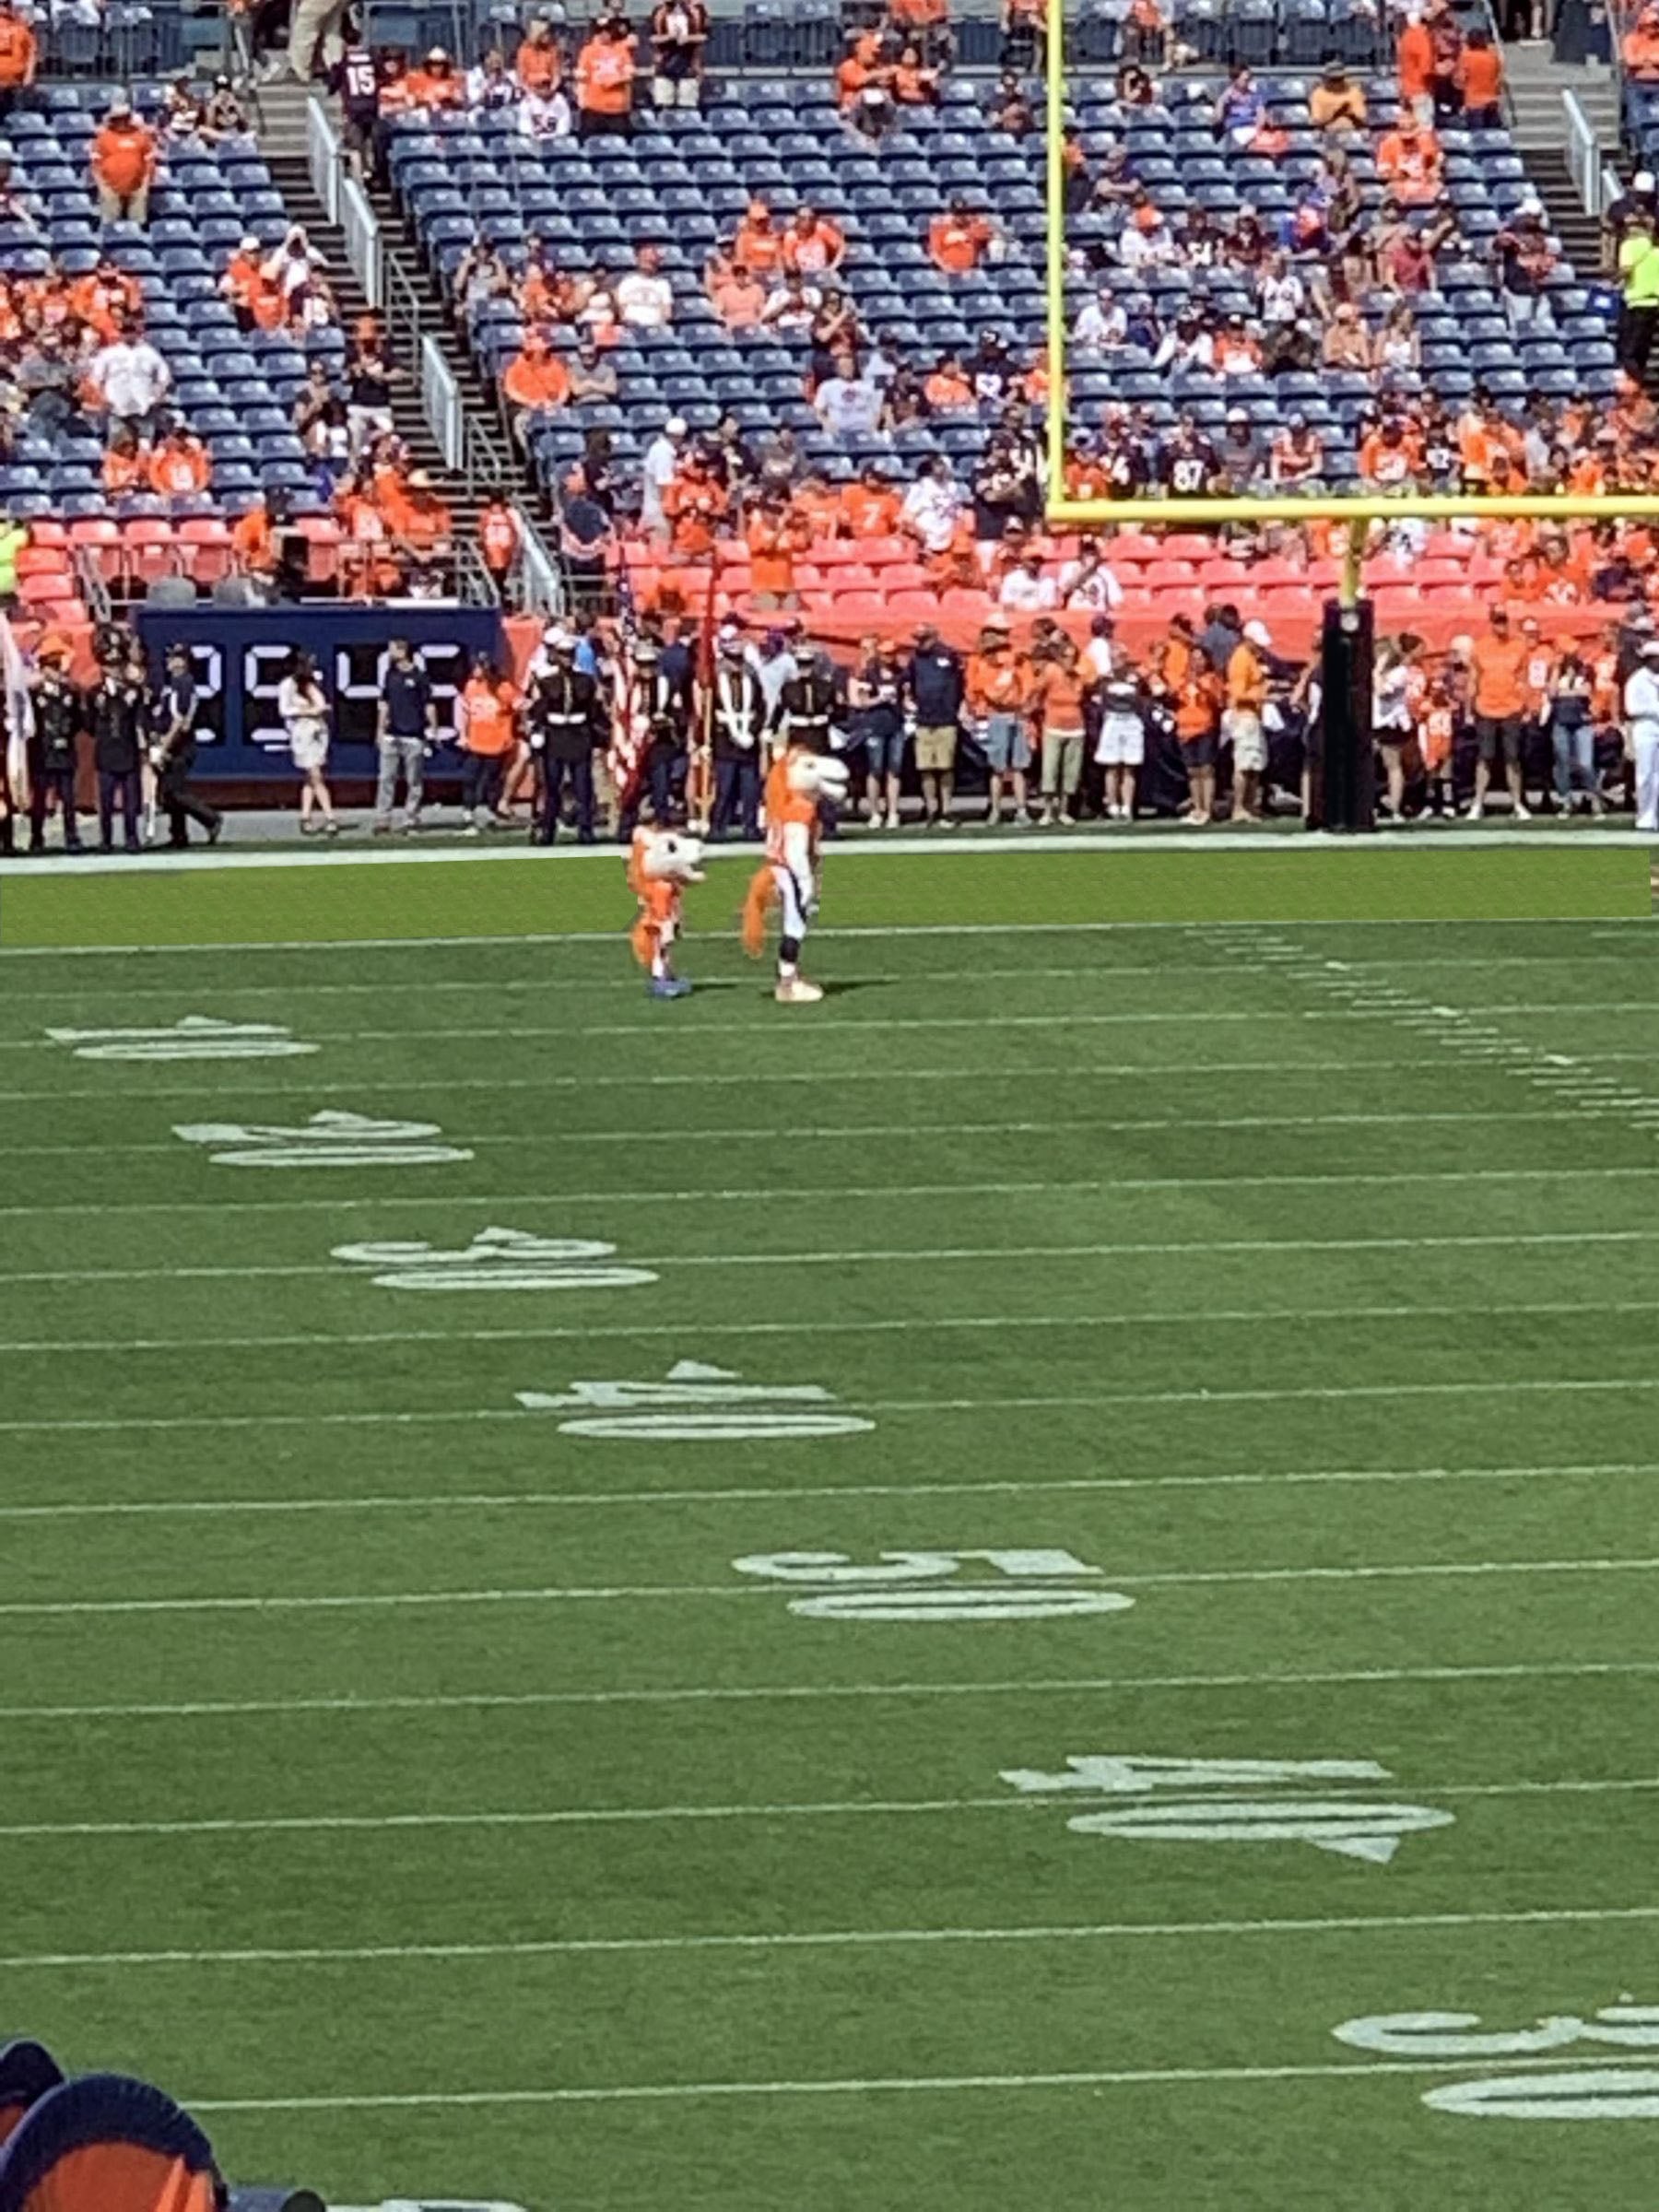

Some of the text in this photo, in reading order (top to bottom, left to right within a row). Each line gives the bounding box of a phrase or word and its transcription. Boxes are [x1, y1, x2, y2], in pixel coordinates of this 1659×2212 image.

[347, 65, 376, 97] 15
[1172, 459, 1204, 492] 87
[862, 502, 883, 530] 7
[171, 1120, 475, 1166] 20
[329, 1238, 660, 1290] 30
[513, 1382, 877, 1439] 40
[731, 1549, 1136, 1620] 50
[997, 1754, 1457, 1840] 40
